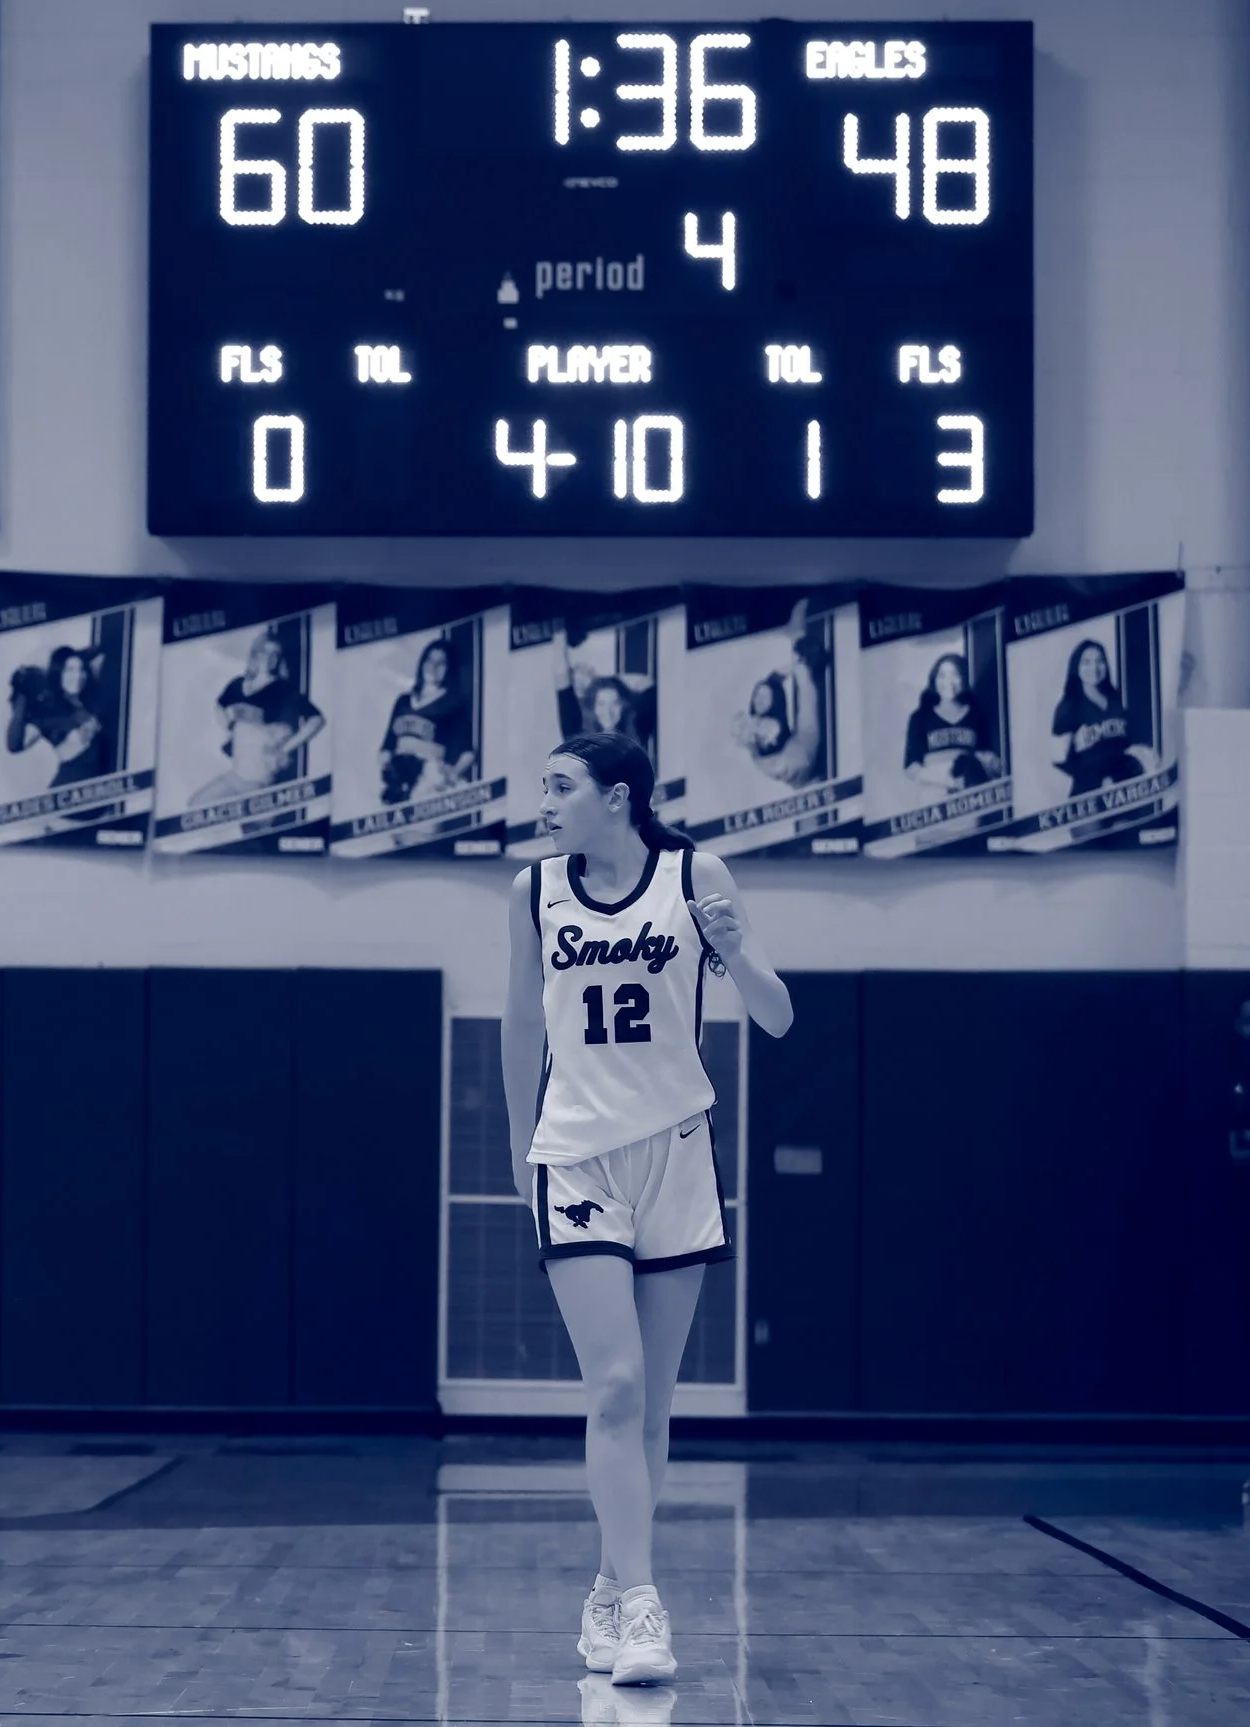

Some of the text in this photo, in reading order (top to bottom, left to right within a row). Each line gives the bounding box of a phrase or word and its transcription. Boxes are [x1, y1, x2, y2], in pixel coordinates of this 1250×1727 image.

[183, 43, 341, 80] MUSTANGS
[806, 41, 926, 79] EAGLES
[555, 33, 756, 151] 1:36
[220, 109, 365, 225] 60
[844, 107, 990, 225] 48
[685, 212, 735, 290] 4
[536, 254, 644, 299] period
[221, 345, 283, 383] FLS
[354, 345, 411, 383] TOL
[527, 345, 652, 383] PLAYER
[765, 345, 822, 383] TOL
[899, 345, 961, 383] FLS
[253, 415, 304, 502] 0
[807, 420, 821, 499] 1
[937, 415, 984, 503] 3
[723, 808, 756, 834] LEA
[890, 802, 941, 834] LUCIA
[1038, 771, 1168, 831] KYLEE VARGAS
[551, 921, 679, 974] Smoky
[582, 983, 651, 1045] 12
